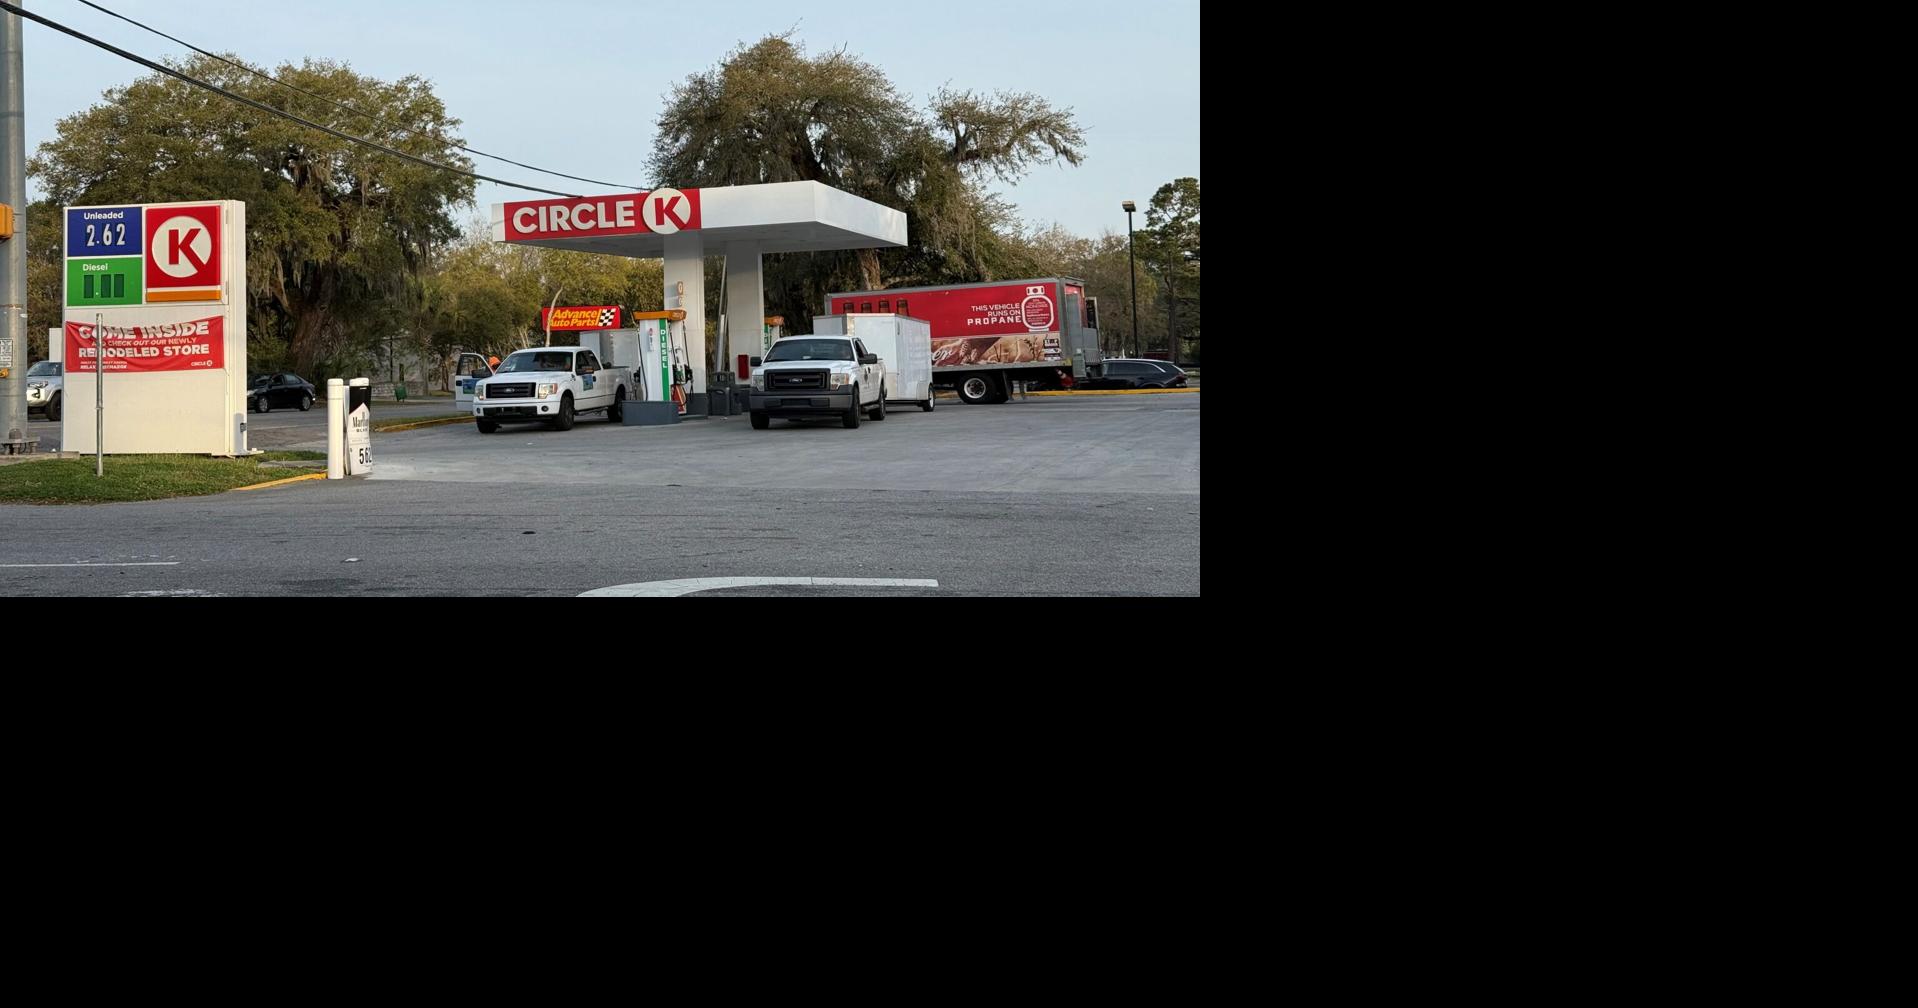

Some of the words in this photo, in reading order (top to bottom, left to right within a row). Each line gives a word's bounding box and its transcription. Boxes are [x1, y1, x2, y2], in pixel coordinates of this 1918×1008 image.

[83, 211, 124, 220] Unleaded
[512, 200, 635, 234] CIRCLE
[86, 223, 126, 246] 2.62
[82, 263, 108, 271] Diesel
[971, 304, 988, 312] THIS
[989, 302, 1020, 311] VEHICLE
[552, 309, 598, 319] Advance
[570, 318, 596, 327] Parts
[967, 316, 1021, 325] PROPANE
[138, 321, 209, 339] INSIDE
[163, 344, 209, 356] STORE
[660, 329, 668, 368] DIESEL
